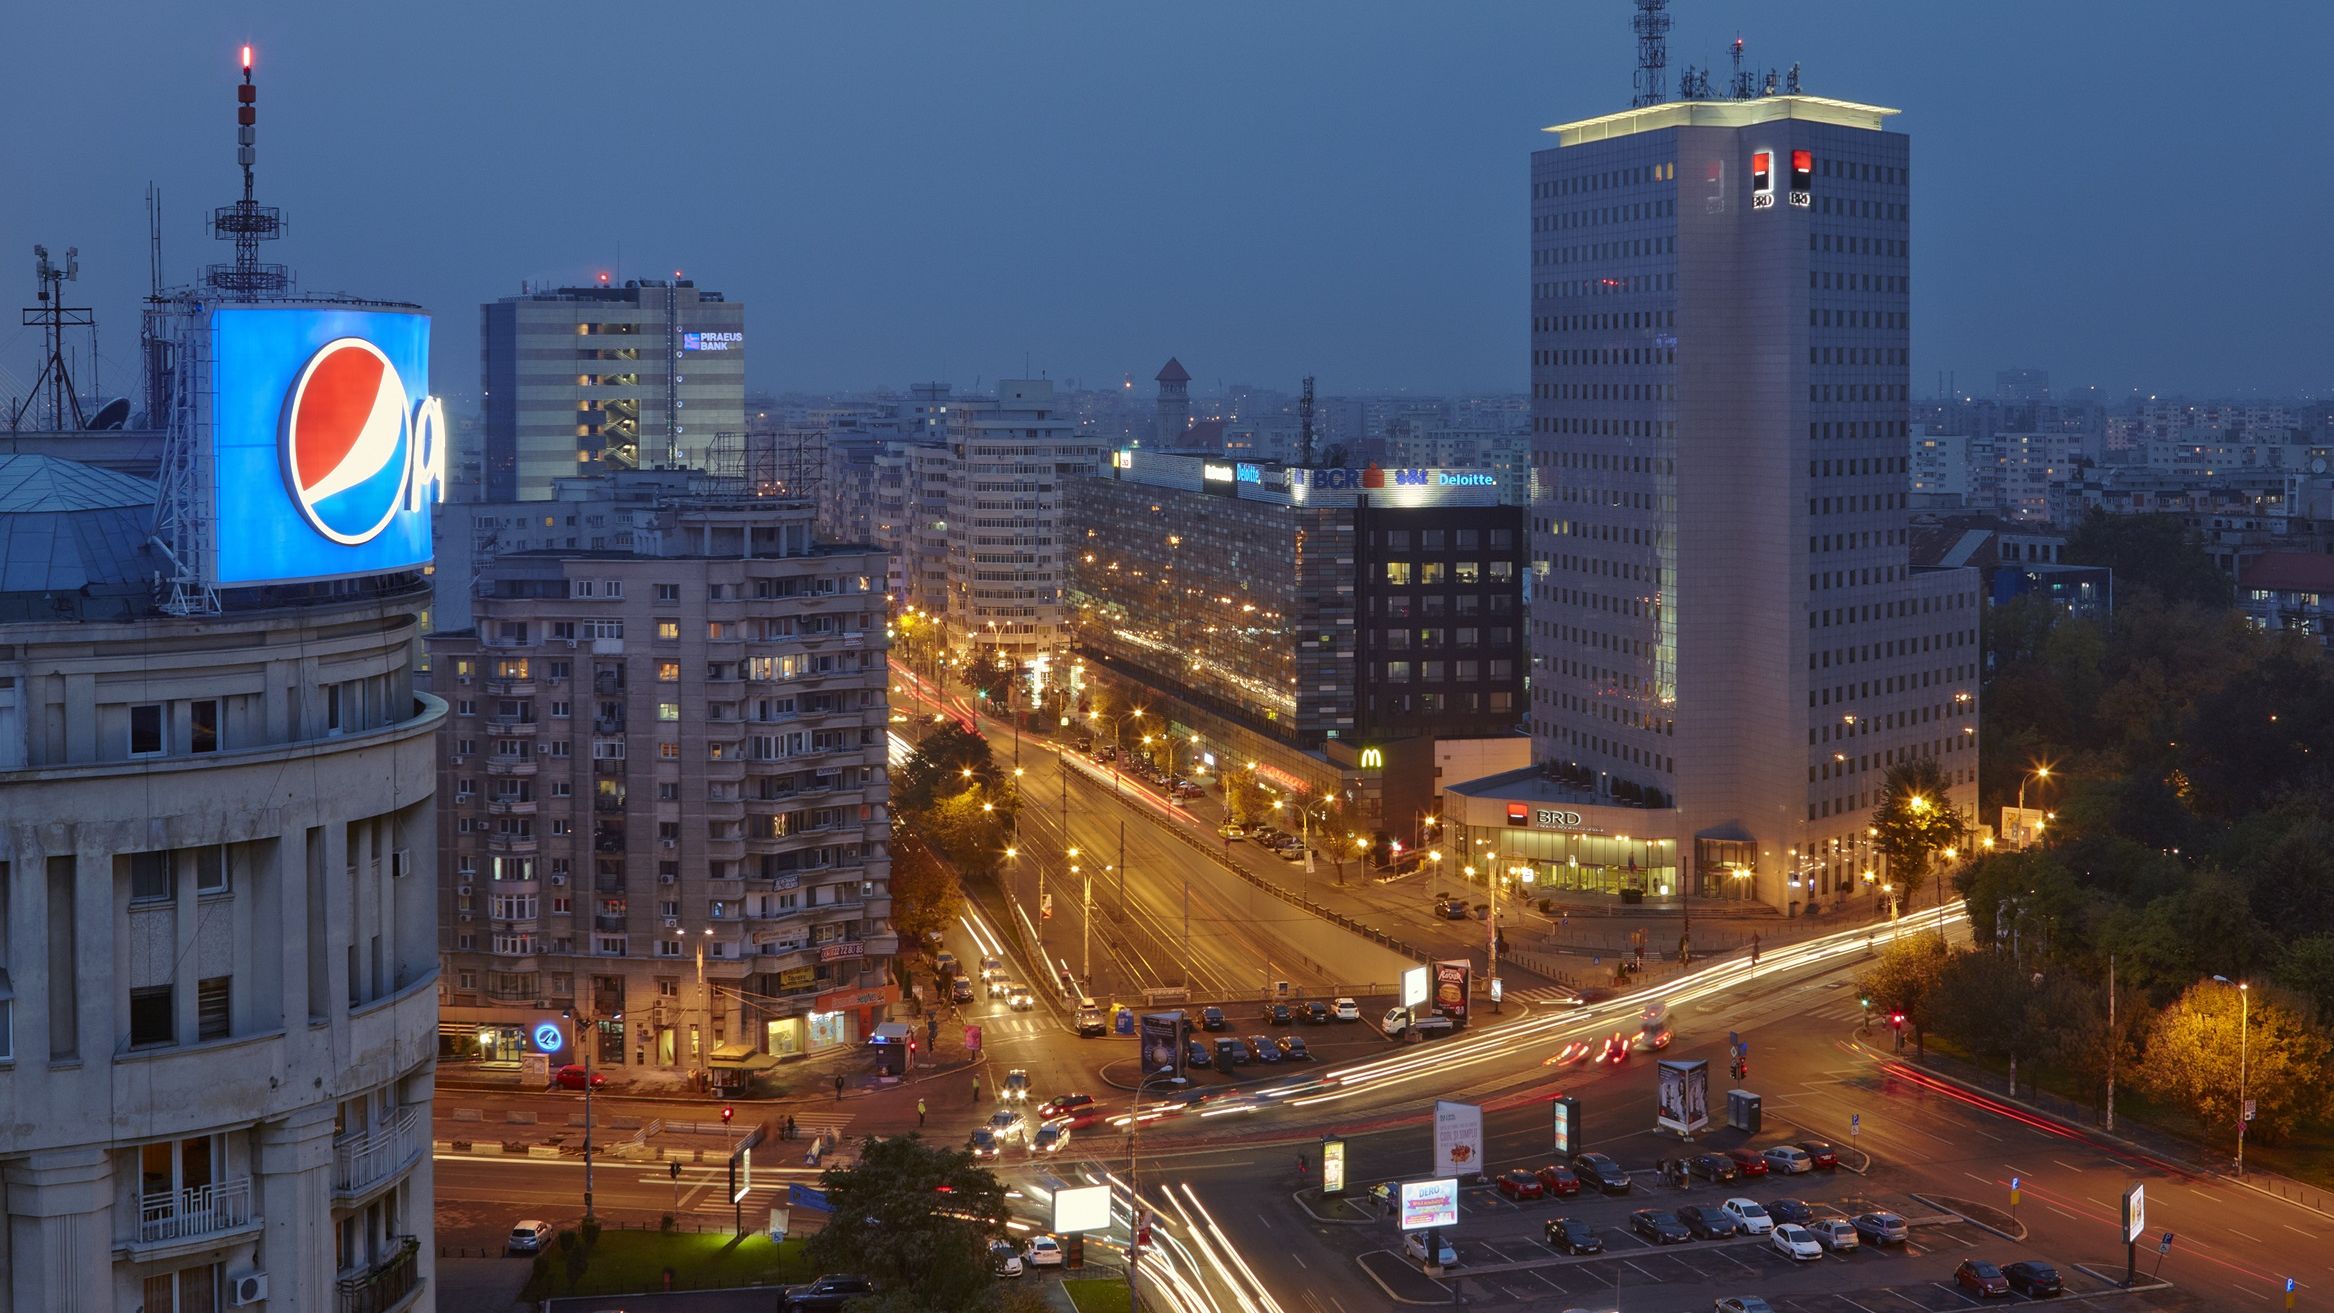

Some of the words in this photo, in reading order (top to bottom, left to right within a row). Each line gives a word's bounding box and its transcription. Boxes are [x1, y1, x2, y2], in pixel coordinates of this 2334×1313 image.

[1752, 194, 1775, 209] BRD
[701, 333, 742, 341] PIRAEUS
[700, 342, 728, 350] BANK
[1313, 469, 1359, 489] BCR
[1439, 473, 1496, 486] Deloitte.
[1536, 809, 1581, 826] BRD
[1418, 1185, 1440, 1198] DERO
